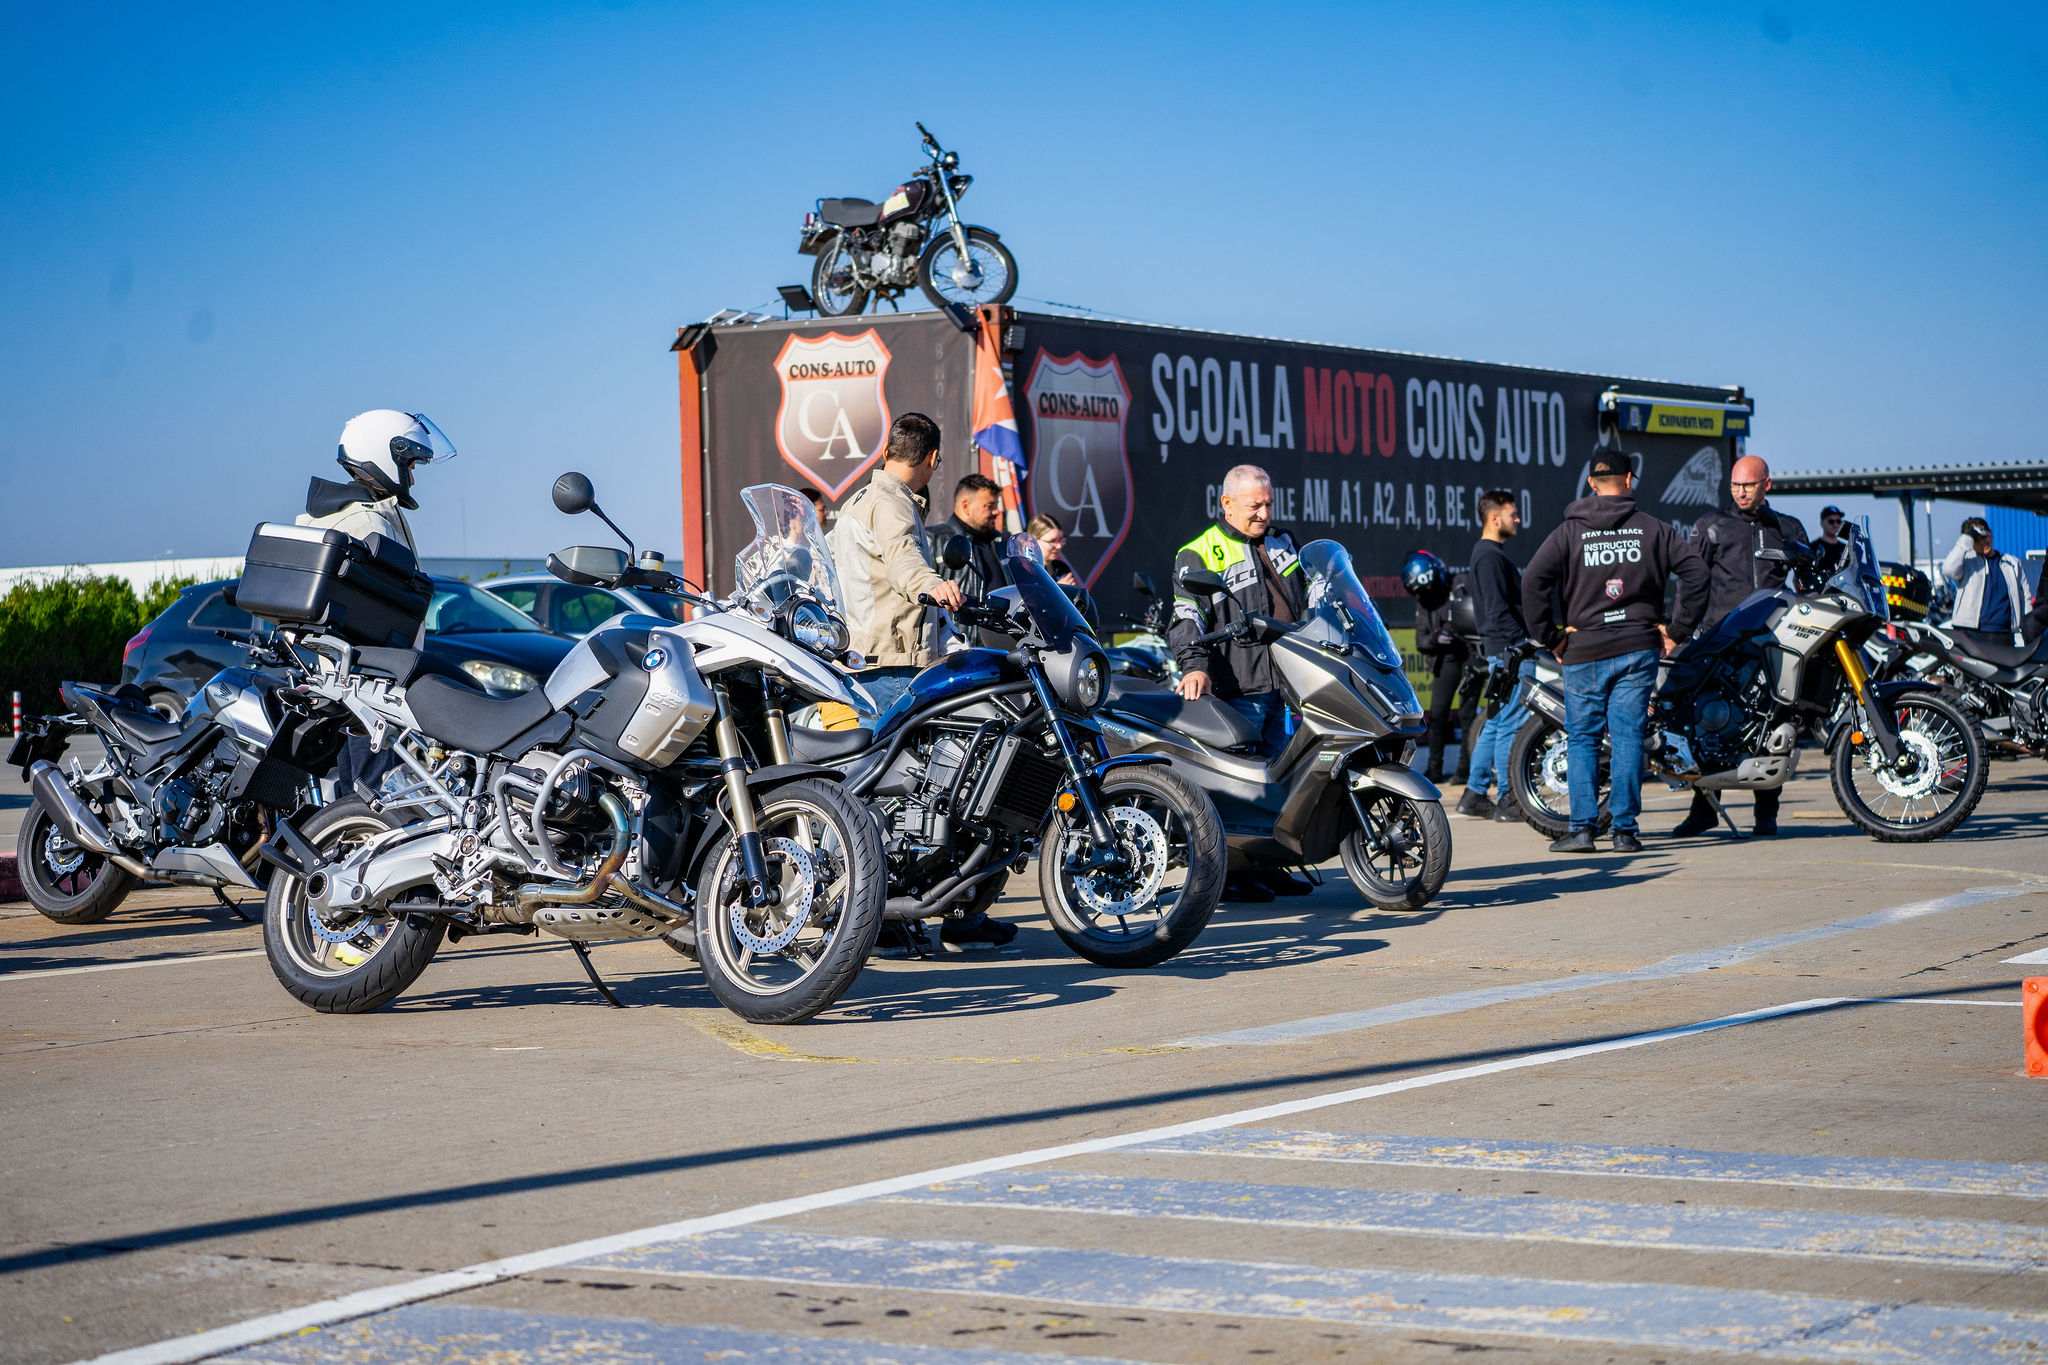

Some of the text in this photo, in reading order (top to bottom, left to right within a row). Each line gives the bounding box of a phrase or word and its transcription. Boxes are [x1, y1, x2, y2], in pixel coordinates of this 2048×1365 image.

[789, 359, 876, 378] CONS-AUTO
[1039, 391, 1120, 419] CONS-AUTO
[1152, 352, 1567, 467] ȘCOALA MOTO CONS AUTO
[1303, 478, 1336, 528] AM,
[1341, 480, 1368, 529] A1,
[1373, 482, 1400, 530] A2,
[1405, 483, 1422, 531] A,
[1425, 484, 1442, 532] B,
[1445, 485, 1471, 533] BE,
[1520, 488, 1532, 529] D
[1581, 530, 1602, 540] STAY
[1617, 528, 1644, 536] TRACK
[1583, 540, 1641, 552] INSTRUCTOR
[1584, 547, 1642, 567] MOTO
